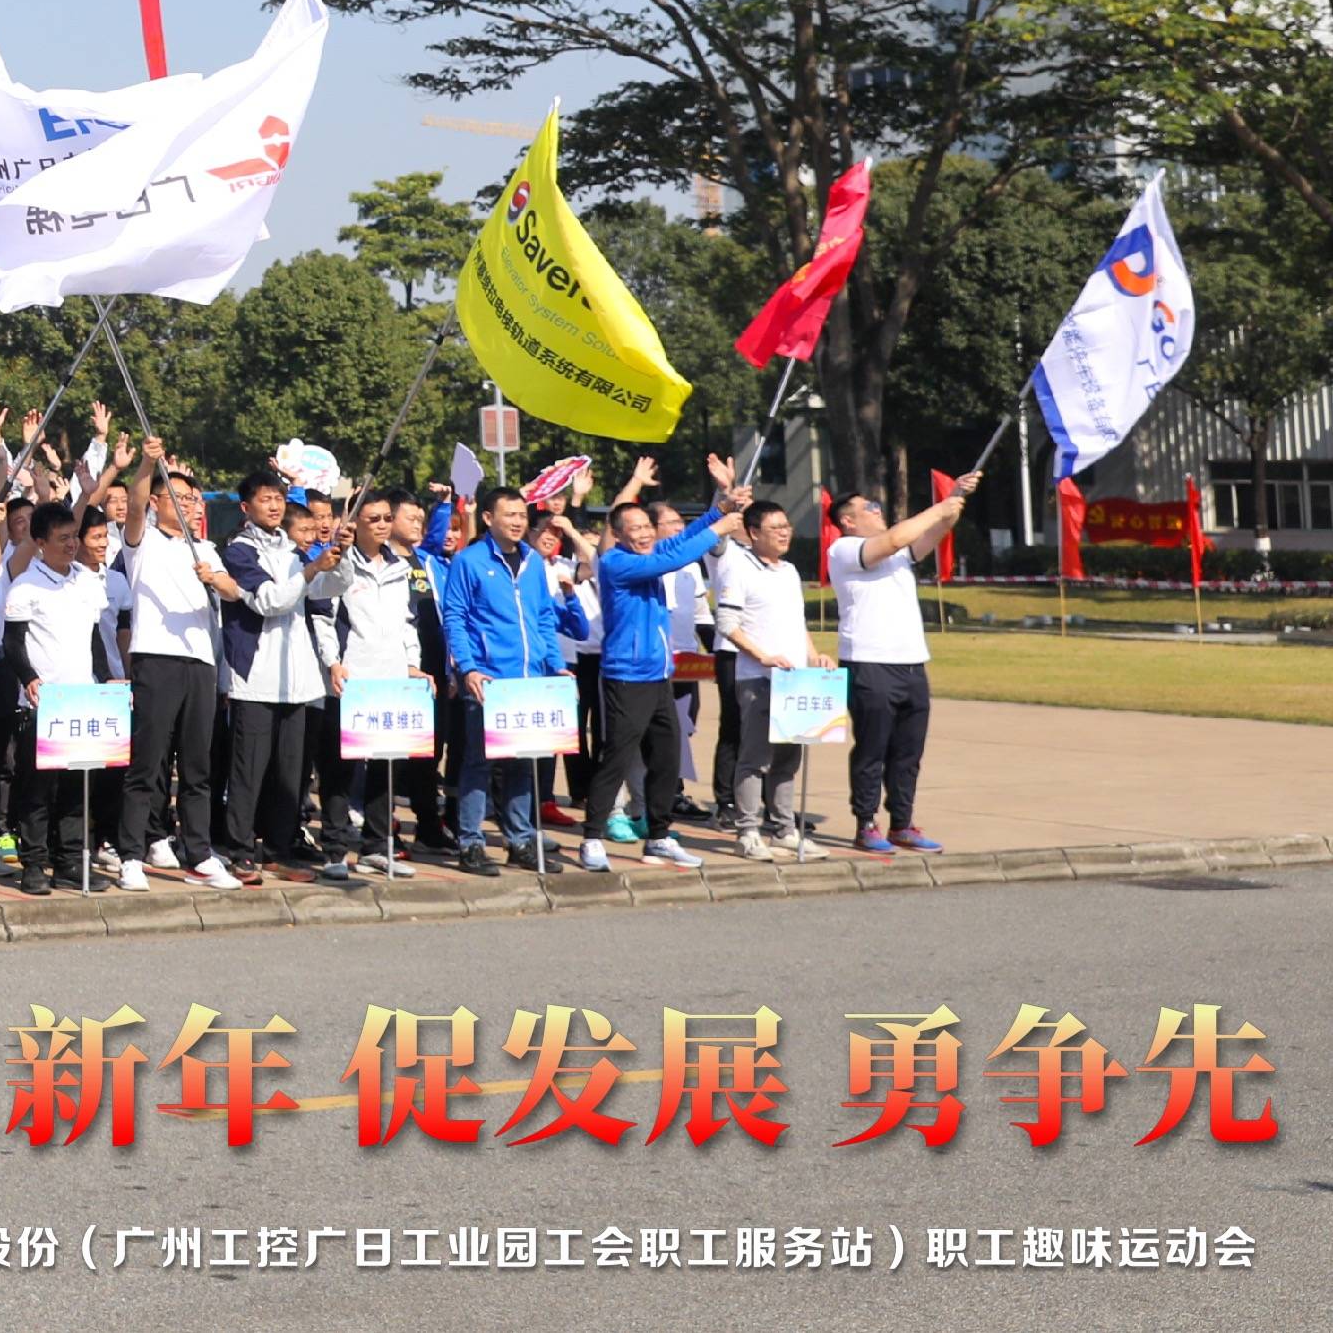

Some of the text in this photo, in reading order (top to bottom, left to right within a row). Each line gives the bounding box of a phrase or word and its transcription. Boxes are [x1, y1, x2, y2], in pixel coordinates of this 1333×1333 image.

[527, 293, 580, 336] System
[48, 717, 120, 738] 广日电气
[352, 710, 424, 730] 广州塞维拉
[494, 709, 566, 729] 日立电机
